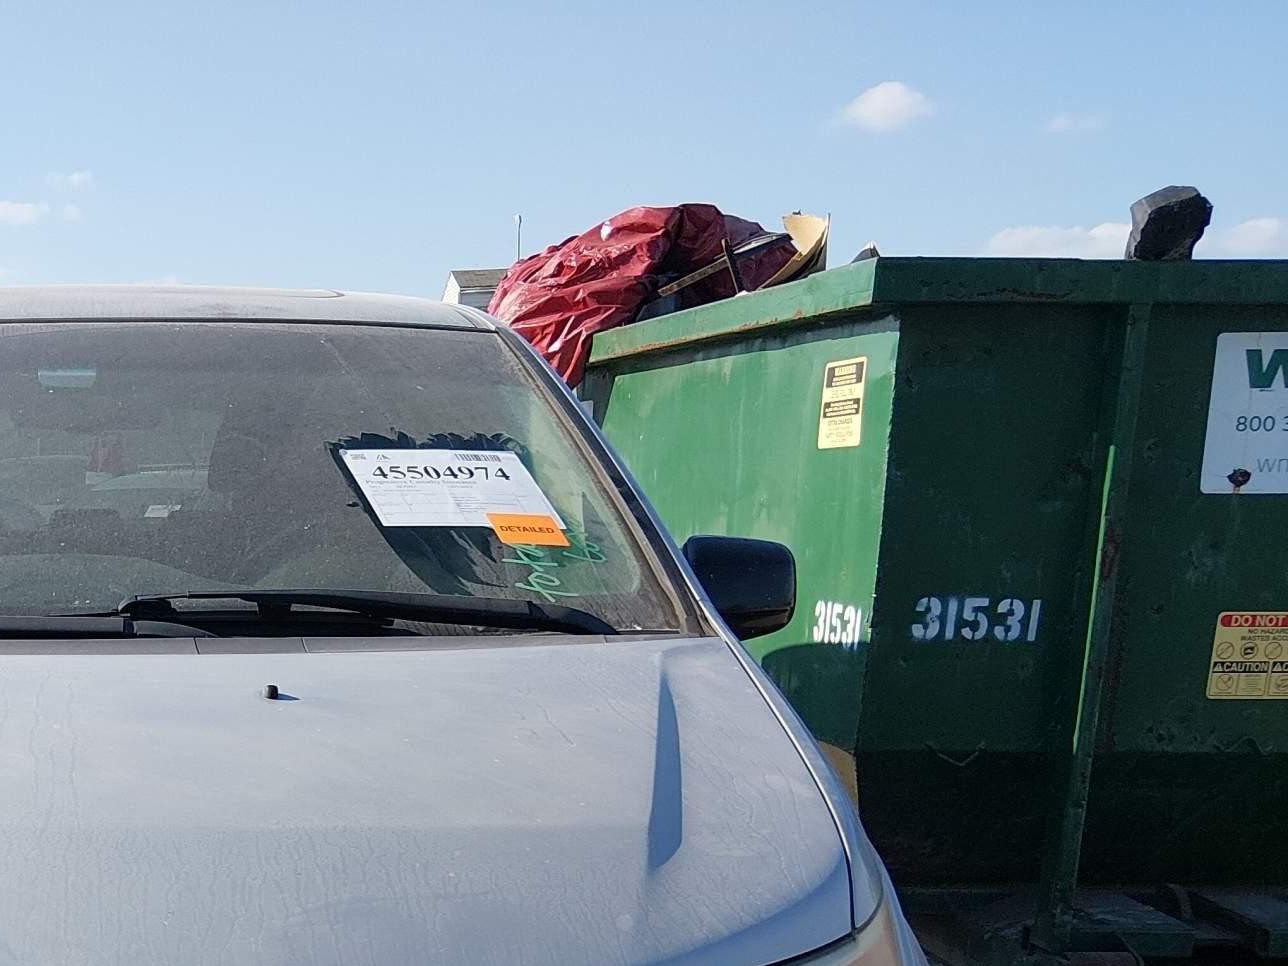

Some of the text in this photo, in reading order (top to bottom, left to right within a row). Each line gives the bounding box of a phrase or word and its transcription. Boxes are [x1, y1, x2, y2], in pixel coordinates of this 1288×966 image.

[1235, 415, 1276, 432] 800
[372, 465, 511, 481] 45504974
[499, 525, 555, 534] DETAILED
[813, 599, 862, 650] 31531
[911, 597, 1042, 643] 31531
[1231, 615, 1287, 627] DO NOT
[1224, 662, 1268, 672] CAUTION
